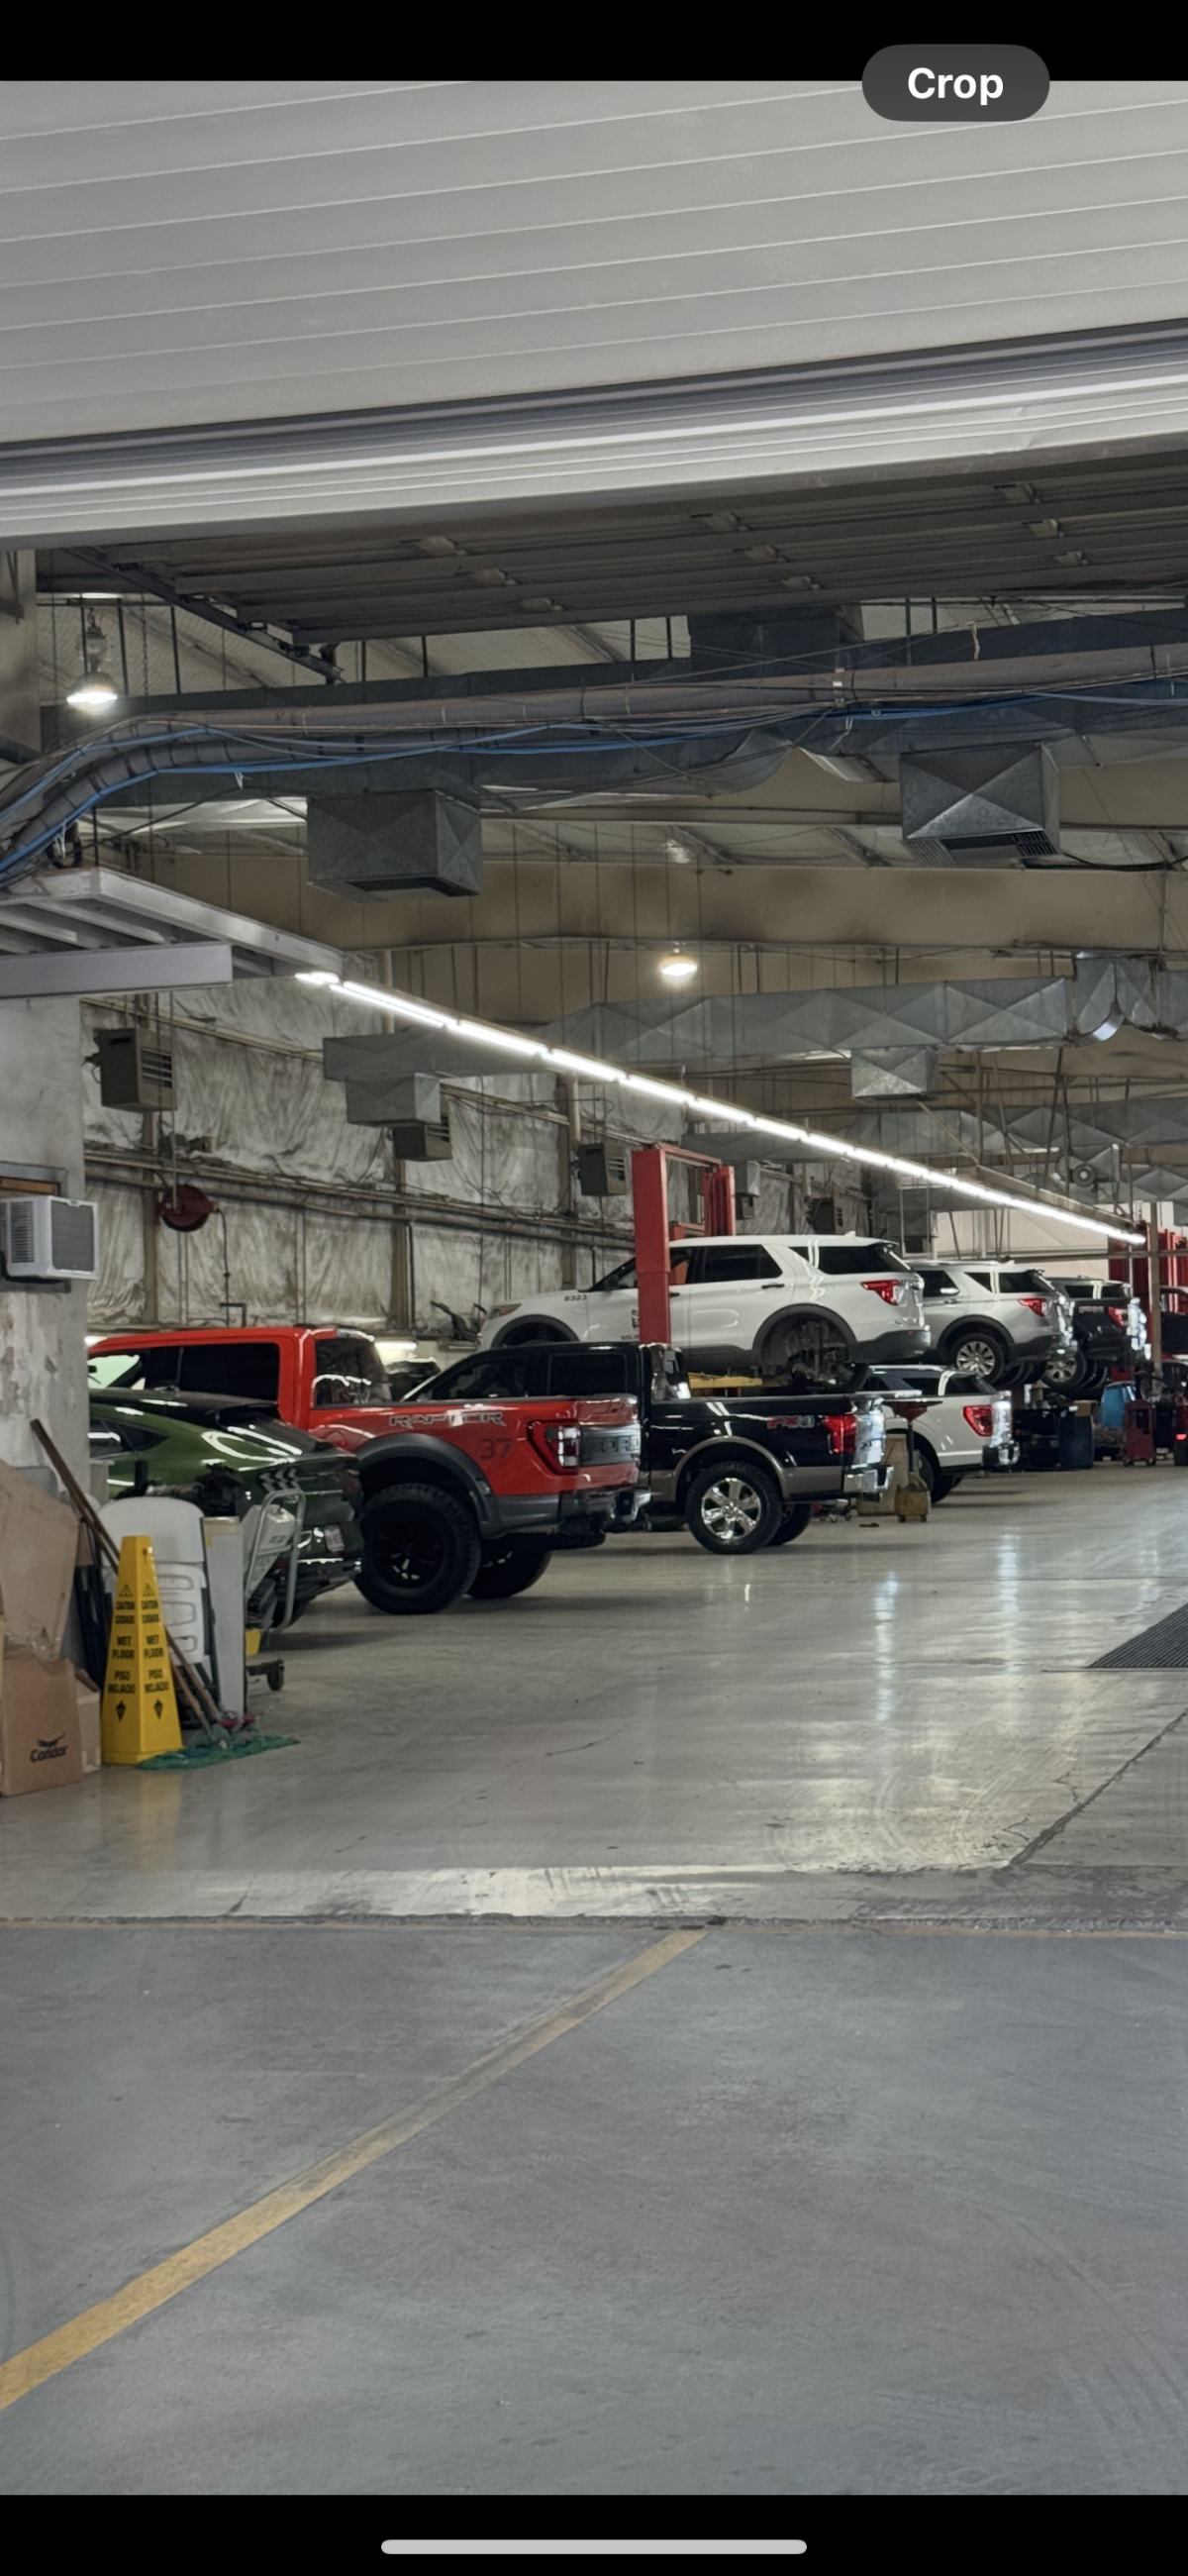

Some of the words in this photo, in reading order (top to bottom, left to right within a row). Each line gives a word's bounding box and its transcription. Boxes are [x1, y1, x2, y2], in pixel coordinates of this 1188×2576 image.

[389, 1410, 507, 1429] RAPTOR
[767, 1414, 815, 1429] FX4
[479, 1437, 512, 1460] 37
[593, 1435, 641, 1454] ORD
[116, 1635, 132, 1645] WET
[146, 1634, 159, 1645] WET
[112, 1649, 135, 1660] FLOOR
[144, 1647, 164, 1659] FLOOR
[114, 1670, 131, 1681] PISO
[148, 1669, 163, 1680] PISO
[108, 1683, 137, 1695] MOJADO
[144, 1682, 169, 1694] MOJADO
[30, 1745, 68, 1763] Condor
